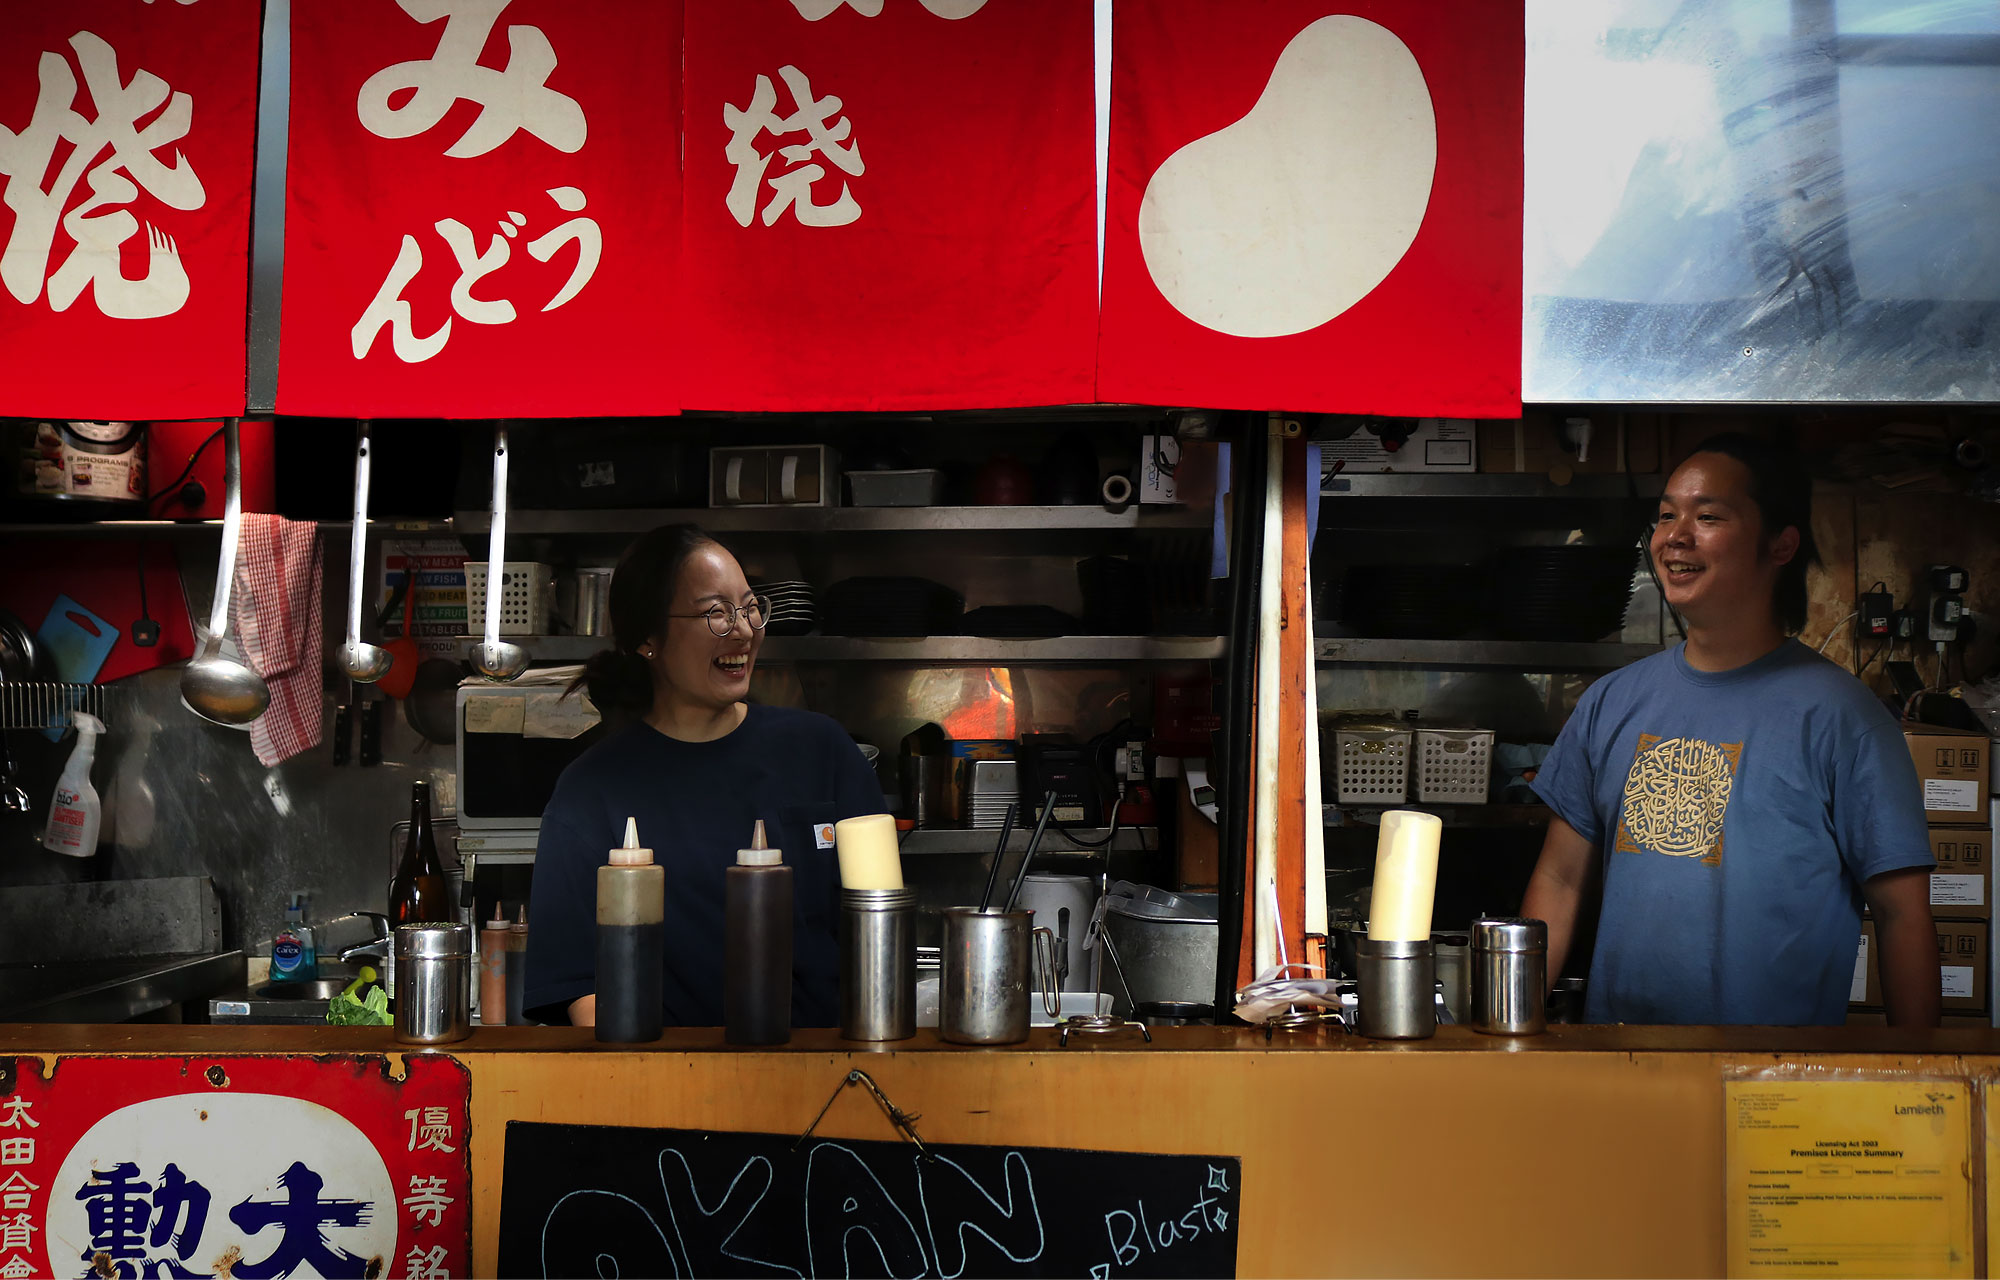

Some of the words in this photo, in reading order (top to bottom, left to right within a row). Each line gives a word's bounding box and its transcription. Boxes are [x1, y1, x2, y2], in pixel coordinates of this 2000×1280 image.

[357, 0, 588, 158] み
[407, 558, 429, 567] RAW
[434, 575, 458, 584] FISH
[276, 946, 299, 954] Carex
[1894, 1104, 1944, 1115] Lambeth
[1864, 1150, 1904, 1158] Summary
[541, 1142, 1045, 1280] OKAN
[1105, 1185, 1218, 1266] Blast
